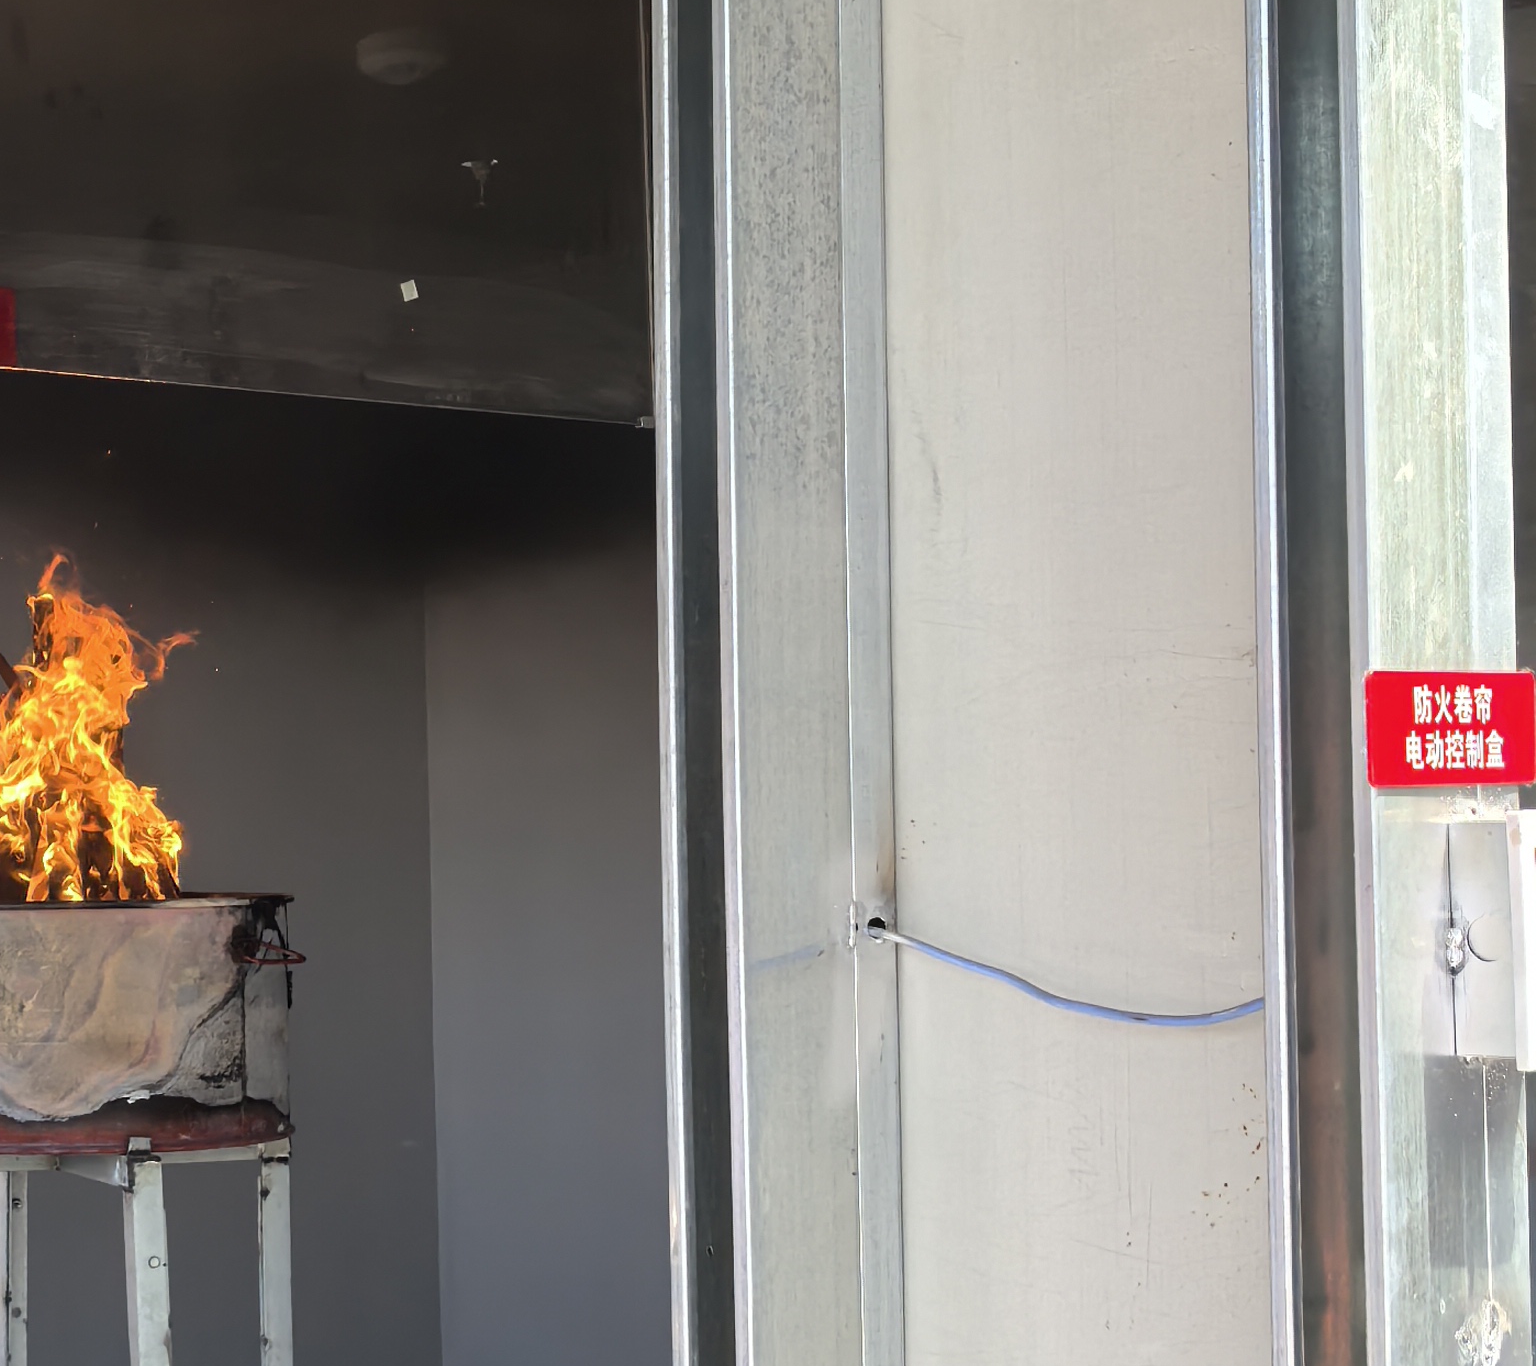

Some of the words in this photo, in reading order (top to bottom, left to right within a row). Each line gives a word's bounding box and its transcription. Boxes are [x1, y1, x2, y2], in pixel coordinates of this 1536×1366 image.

[1412, 684, 1493, 725] 防火卷帘
[1405, 729, 1505, 770] 电动控制盒
